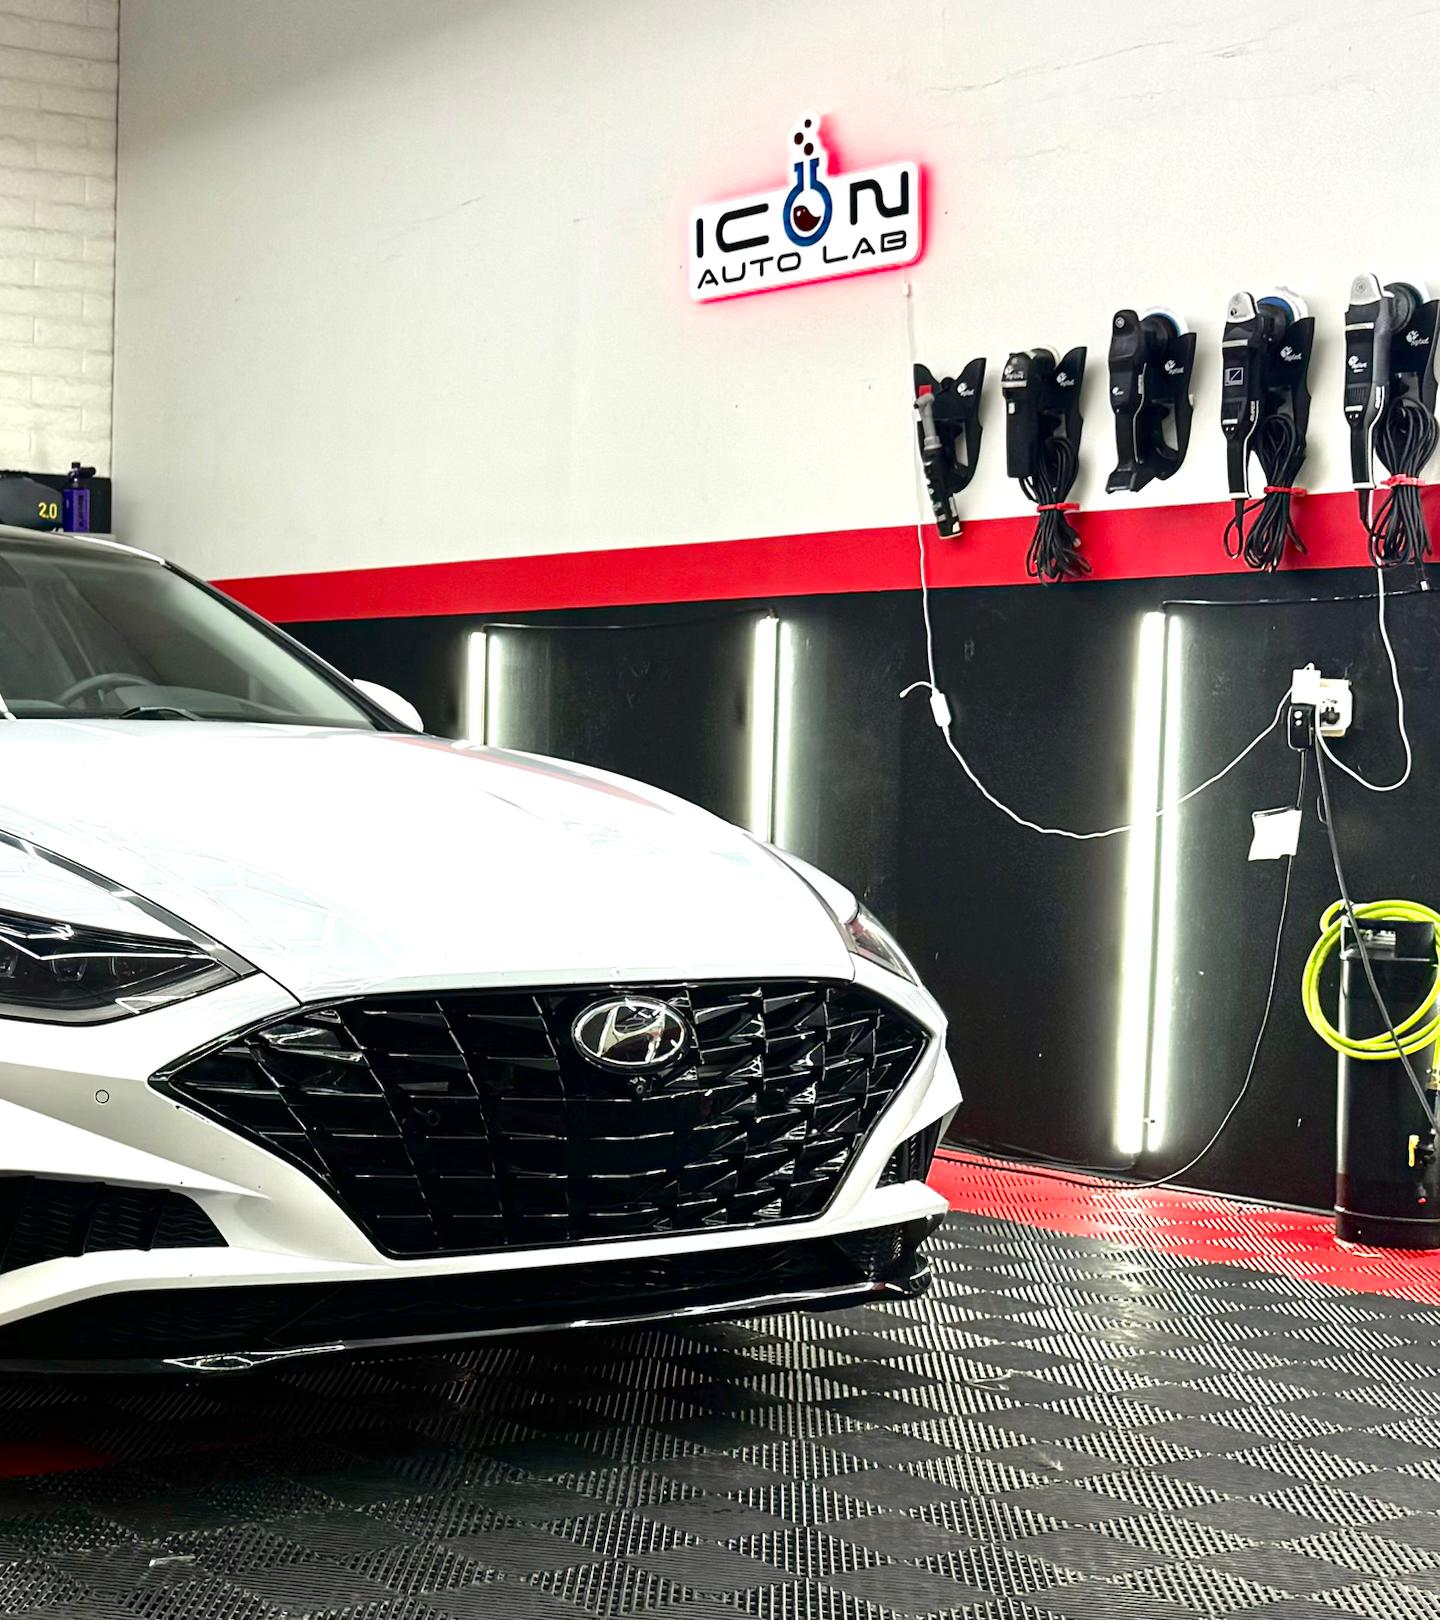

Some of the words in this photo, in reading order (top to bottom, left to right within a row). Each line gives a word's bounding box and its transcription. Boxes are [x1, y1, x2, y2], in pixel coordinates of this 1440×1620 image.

[696, 158, 909, 258] ICON
[697, 251, 802, 289] AUTO
[822, 229, 907, 264] LAB
[38, 502, 58, 519] 2.0
